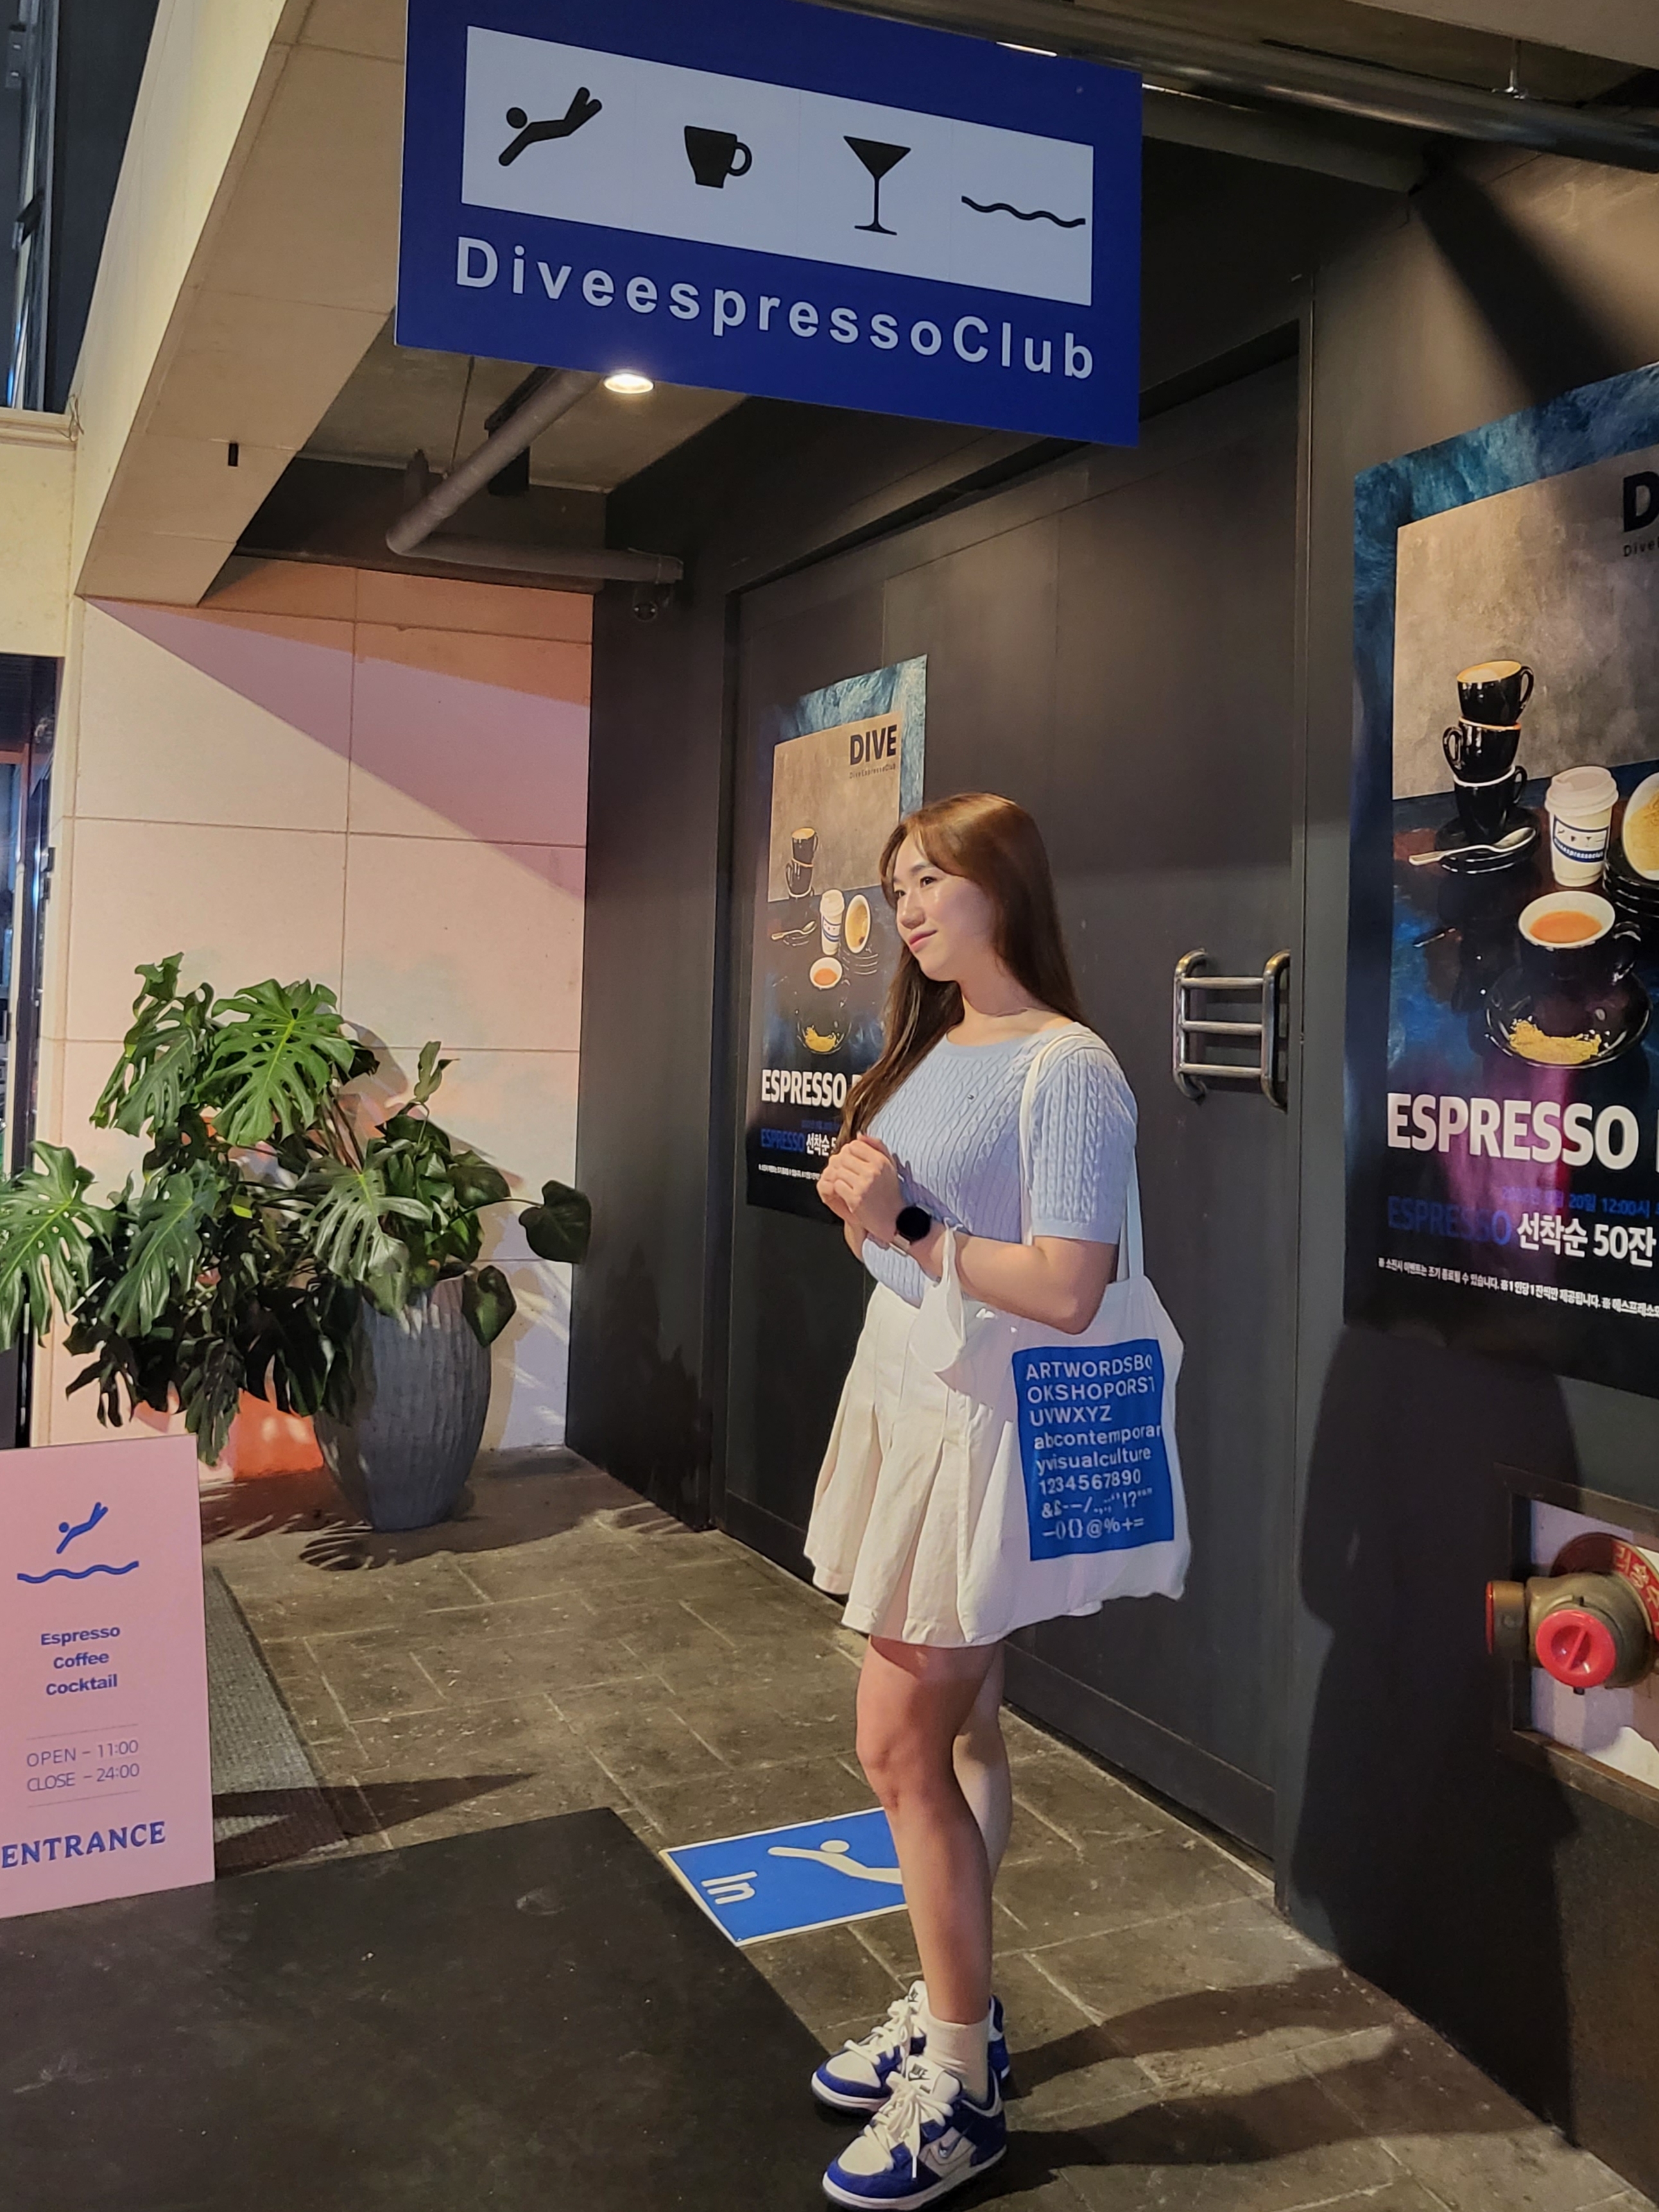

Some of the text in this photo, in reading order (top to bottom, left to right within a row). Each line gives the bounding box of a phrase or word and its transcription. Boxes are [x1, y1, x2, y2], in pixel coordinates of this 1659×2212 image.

[456, 236, 1093, 379] DiveespressoClub
[850, 724, 897, 766] DIVE
[761, 1069, 847, 1108] ESPRESSO
[806, 1133, 830, 1156] 선착순
[1387, 1092, 1639, 1170] ESPRESSO
[1388, 1196, 1512, 1246] ESPRESSO
[1517, 1212, 1588, 1258] 선착순
[1593, 1224, 1656, 1267] 50잔
[1029, 1405, 1112, 1427] UVWXYZ
[1033, 1425, 1161, 1450] abcontemporar
[1036, 1447, 1151, 1476] yvisualculture
[1038, 1468, 1142, 1495] 1234567890
[40, 1627, 121, 1647] Espresso
[53, 1652, 110, 1669] Coffee
[46, 1674, 117, 1695] Cocktail
[26, 1747, 76, 1767] OPEN
[98, 1740, 139, 1758] 11:00
[26, 1772, 76, 1792] CLOSE
[96, 1763, 140, 1782] 24:00
[1, 1821, 166, 1868] ENTRANCE
